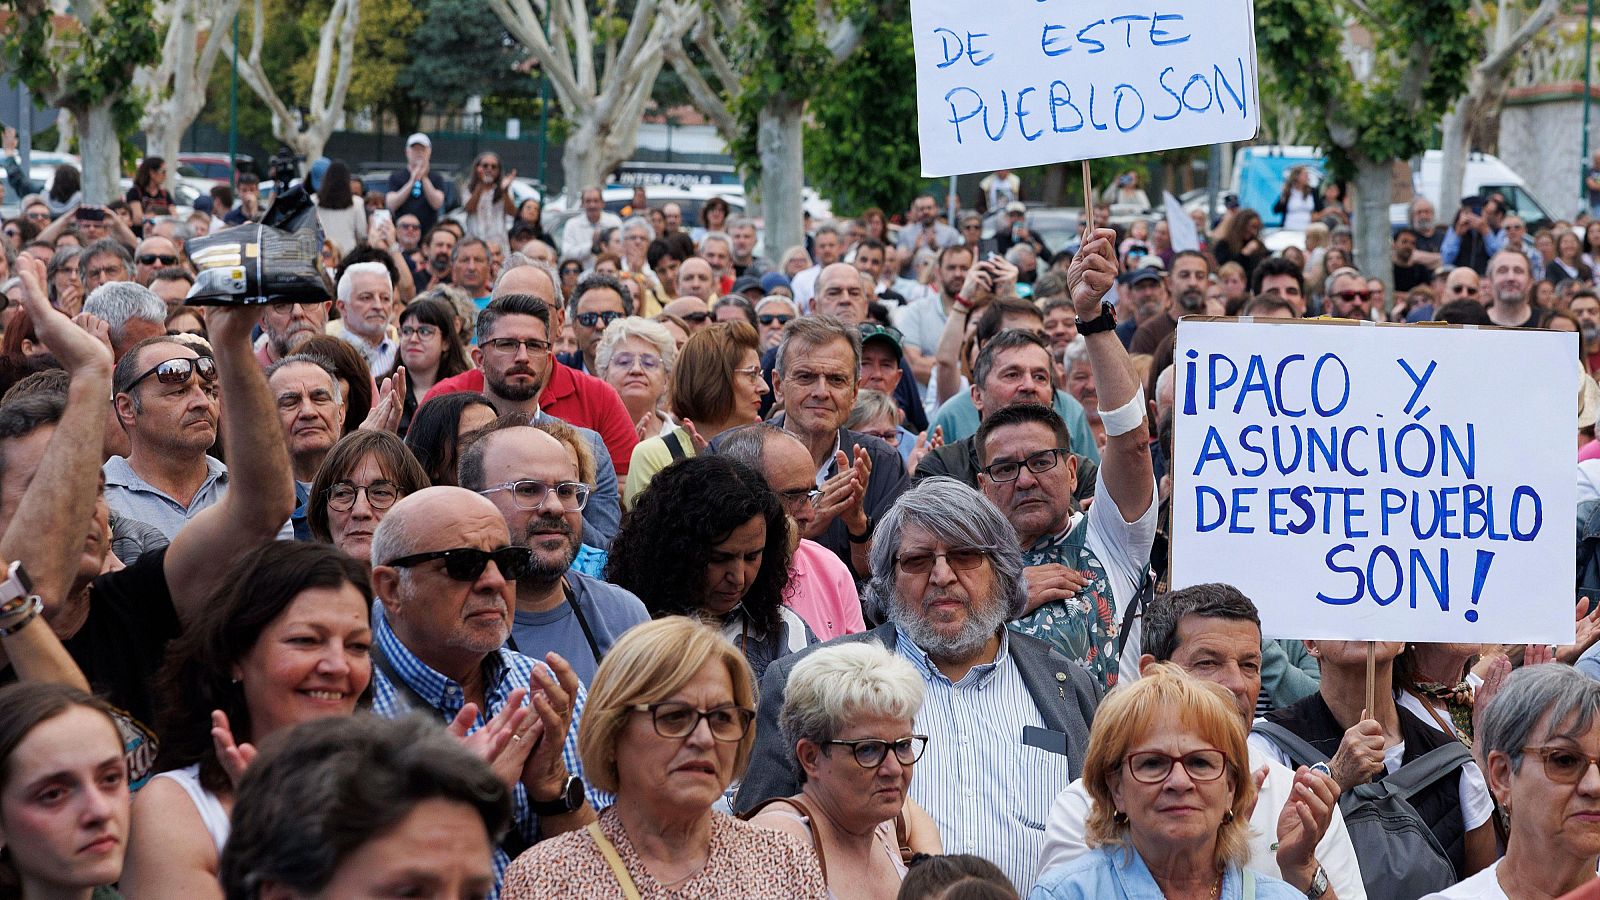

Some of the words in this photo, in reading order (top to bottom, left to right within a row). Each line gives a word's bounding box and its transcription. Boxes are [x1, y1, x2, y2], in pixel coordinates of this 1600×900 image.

[934, 27, 994, 68] DE
[1041, 12, 1191, 56] ESTE
[945, 79, 1144, 144] PUEBLO
[1153, 57, 1246, 121] SON
[1397, 357, 1437, 415] Y
[1195, 484, 1259, 535] DE
[1268, 484, 1369, 539] ESTE
[1380, 483, 1543, 542] PUEBLO
